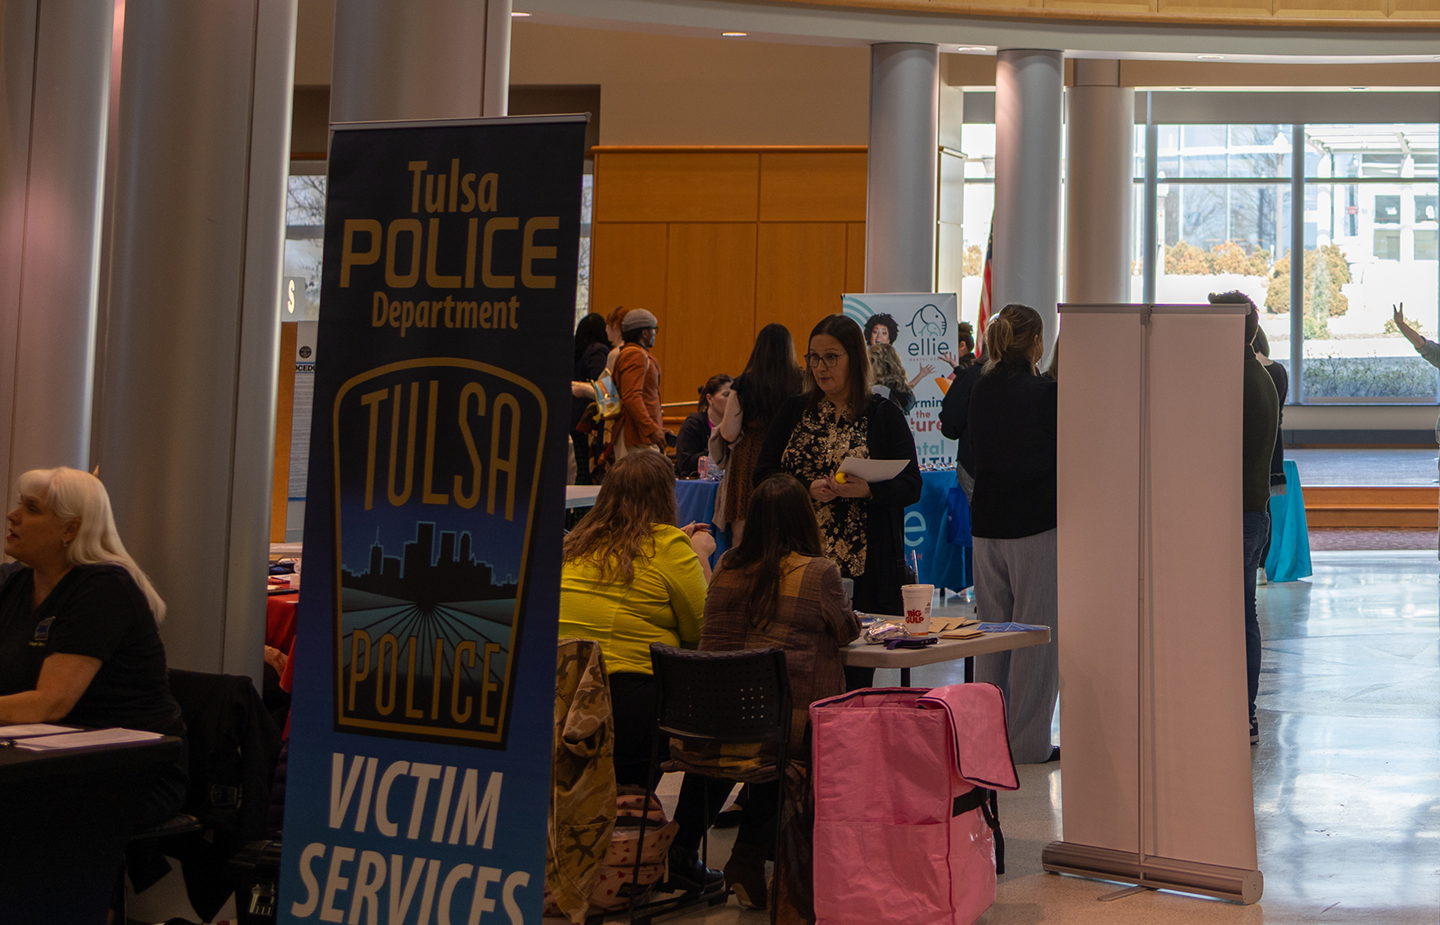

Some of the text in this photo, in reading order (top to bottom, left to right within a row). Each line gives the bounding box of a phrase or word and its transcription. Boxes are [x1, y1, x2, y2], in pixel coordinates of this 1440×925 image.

[407, 158, 499, 213] Tulsa
[339, 216, 560, 289] POLICE
[371, 291, 520, 337] Department
[908, 337, 949, 356] ellie
[916, 410, 931, 418] the
[360, 379, 521, 522] TULSA
[916, 440, 944, 455] ntal
[905, 616, 925, 624] GULP
[348, 628, 500, 726] POLICE
[328, 752, 504, 850] VICTIM
[291, 842, 531, 925] SERVICES
